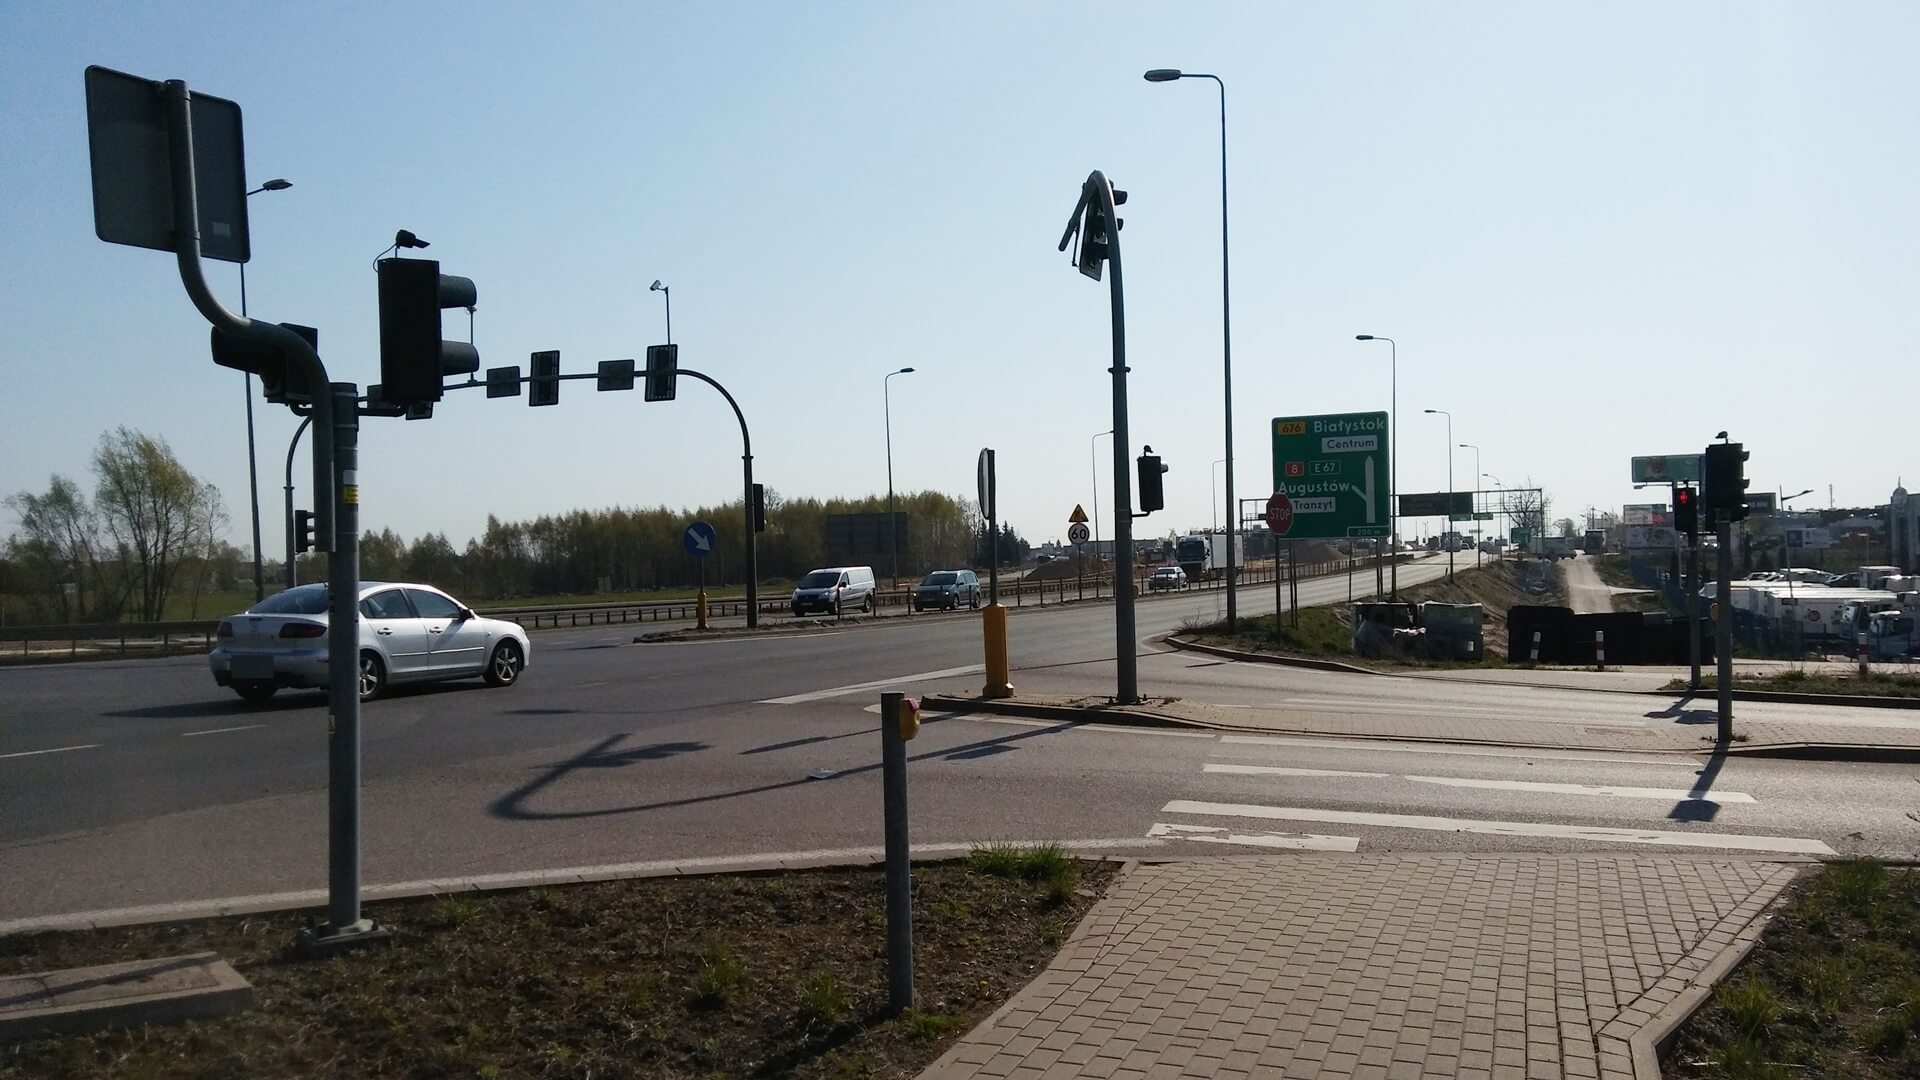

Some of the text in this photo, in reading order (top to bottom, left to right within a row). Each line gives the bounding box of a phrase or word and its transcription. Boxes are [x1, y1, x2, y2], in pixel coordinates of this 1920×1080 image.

[1282, 424, 1301, 433] 676
[1313, 418, 1384, 434] Białystok
[1327, 439, 1374, 449] Centrum
[1291, 464, 1298, 473] 8
[1278, 480, 1349, 496] Augustów
[1294, 500, 1333, 512] Tranzyt
[1270, 508, 1290, 521] STOP
[1071, 528, 1087, 539] 60
